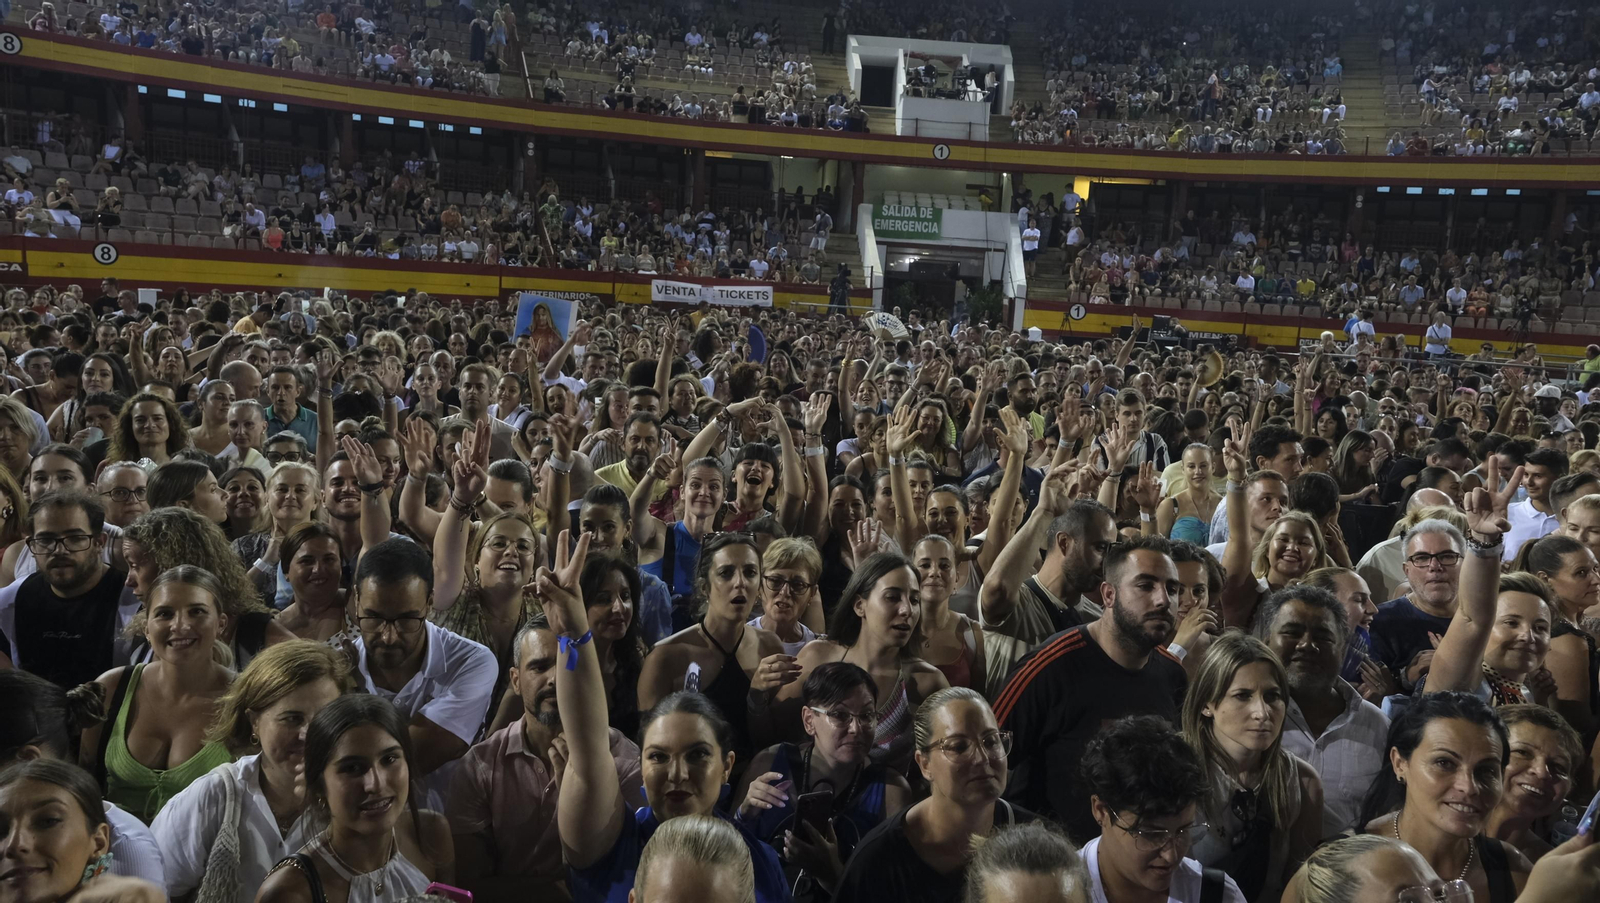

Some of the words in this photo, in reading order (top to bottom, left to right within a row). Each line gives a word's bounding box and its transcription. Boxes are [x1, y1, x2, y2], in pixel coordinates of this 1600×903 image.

[3, 35, 15, 51] 8
[882, 205, 917, 217] SALIDA
[920, 207, 933, 218] DE
[874, 218, 938, 233] EMERGENCIA
[100, 246, 112, 261] 8
[655, 284, 696, 296] VENTA
[718, 289, 769, 300] TICKETS
